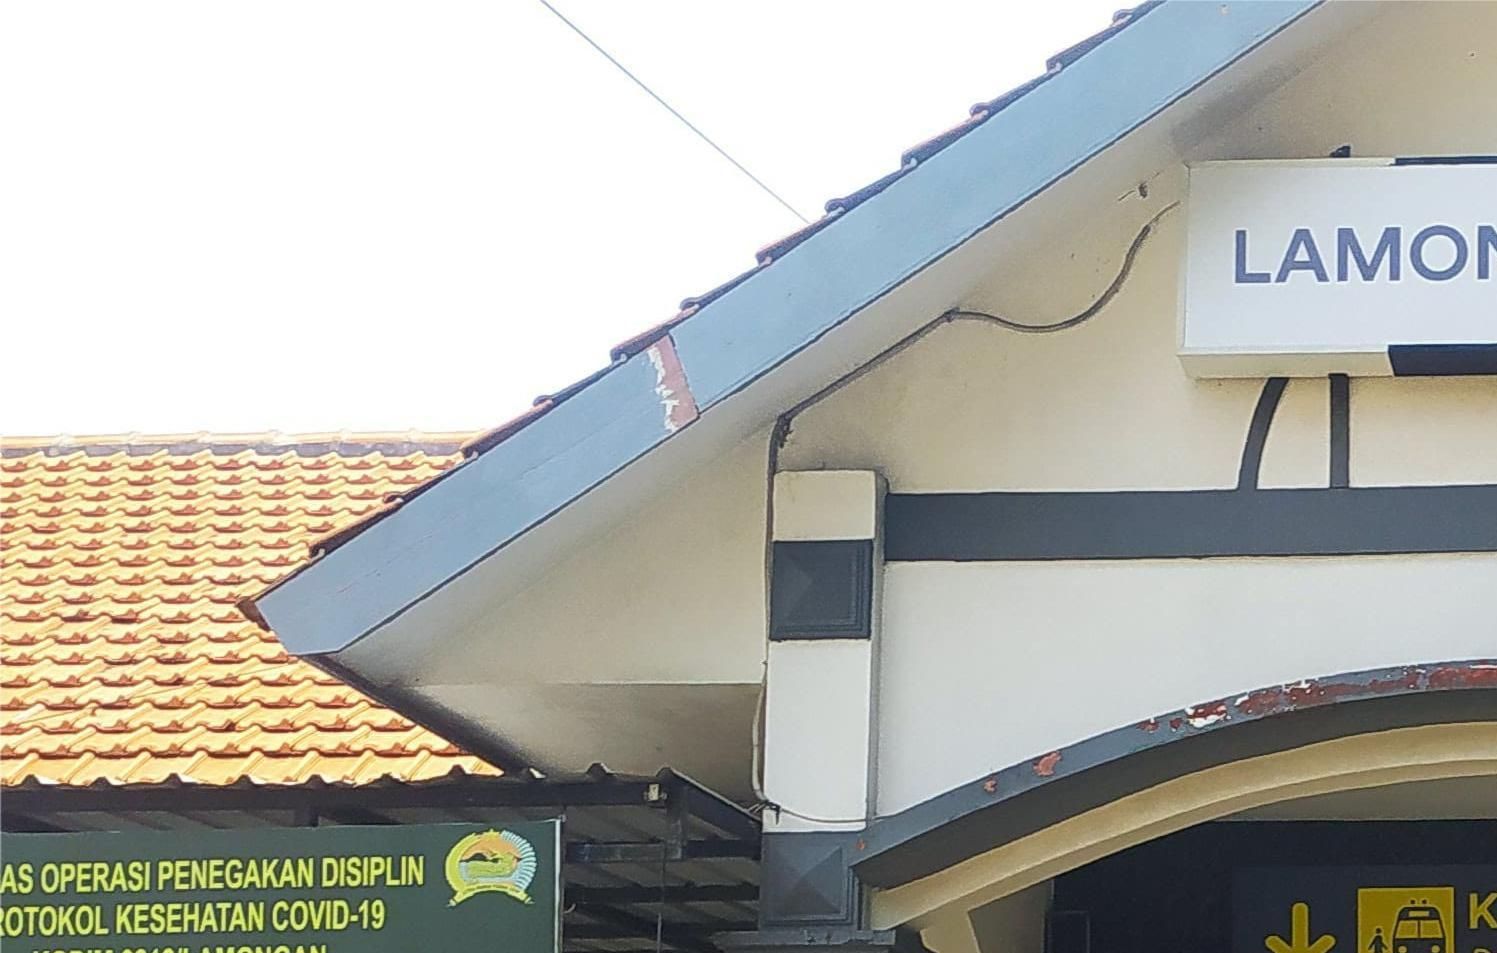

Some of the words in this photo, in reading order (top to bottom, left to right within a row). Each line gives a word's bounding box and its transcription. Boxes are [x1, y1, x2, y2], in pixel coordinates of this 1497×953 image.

[41, 861, 150, 892] OPERASI
[158, 858, 314, 891] PENEGAKAN
[322, 855, 424, 887] DISIPLIN
[116, 902, 265, 935] KESEHATAN
[272, 900, 386, 931] COVID-19
